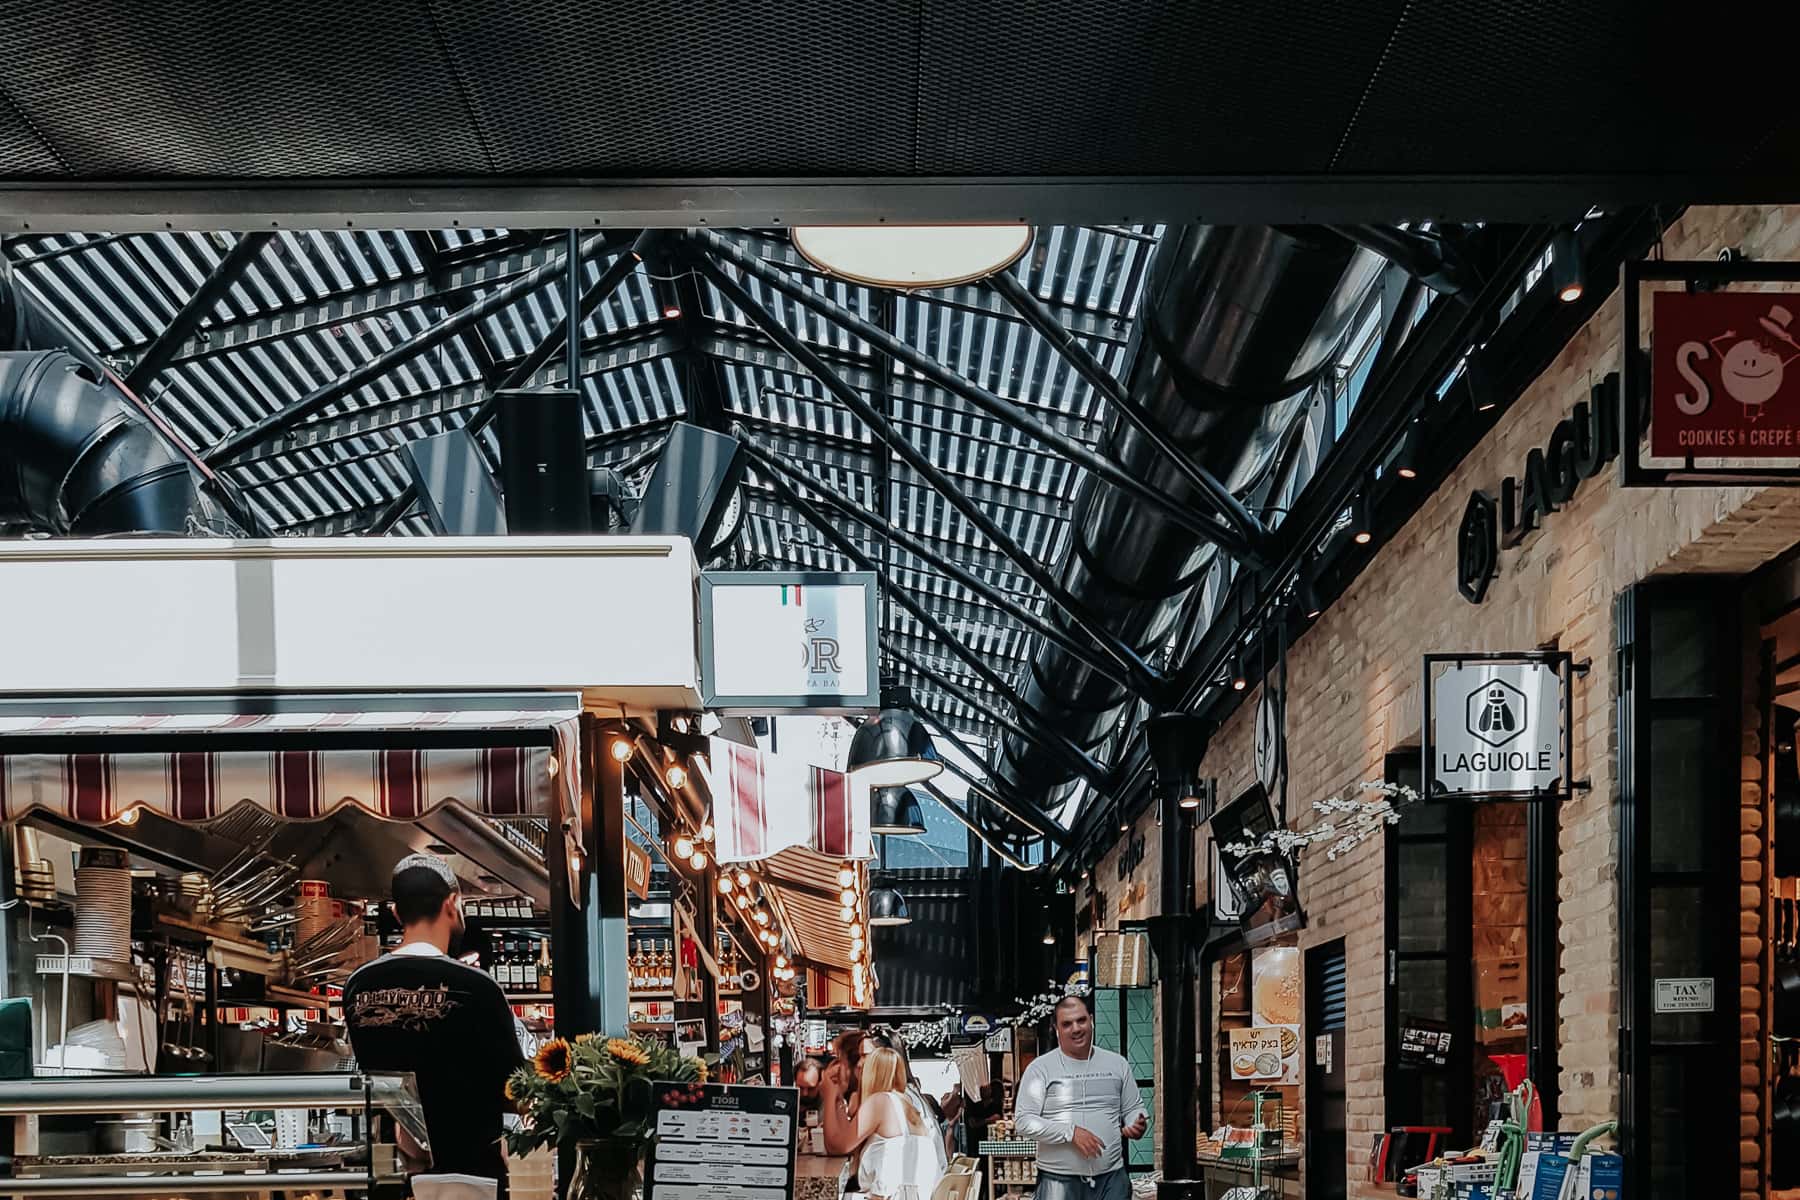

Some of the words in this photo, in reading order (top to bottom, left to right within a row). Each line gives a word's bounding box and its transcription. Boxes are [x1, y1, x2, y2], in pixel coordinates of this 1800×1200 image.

[1679, 429, 1735, 445] COOKIES
[1443, 751, 1551, 773] LAGUIOLE
[1673, 985, 1697, 995] TAX
[1250, 1031, 1261, 1039] יש
[1233, 1040, 1258, 1051] קדאיף
[1261, 1040, 1279, 1049] בצק
